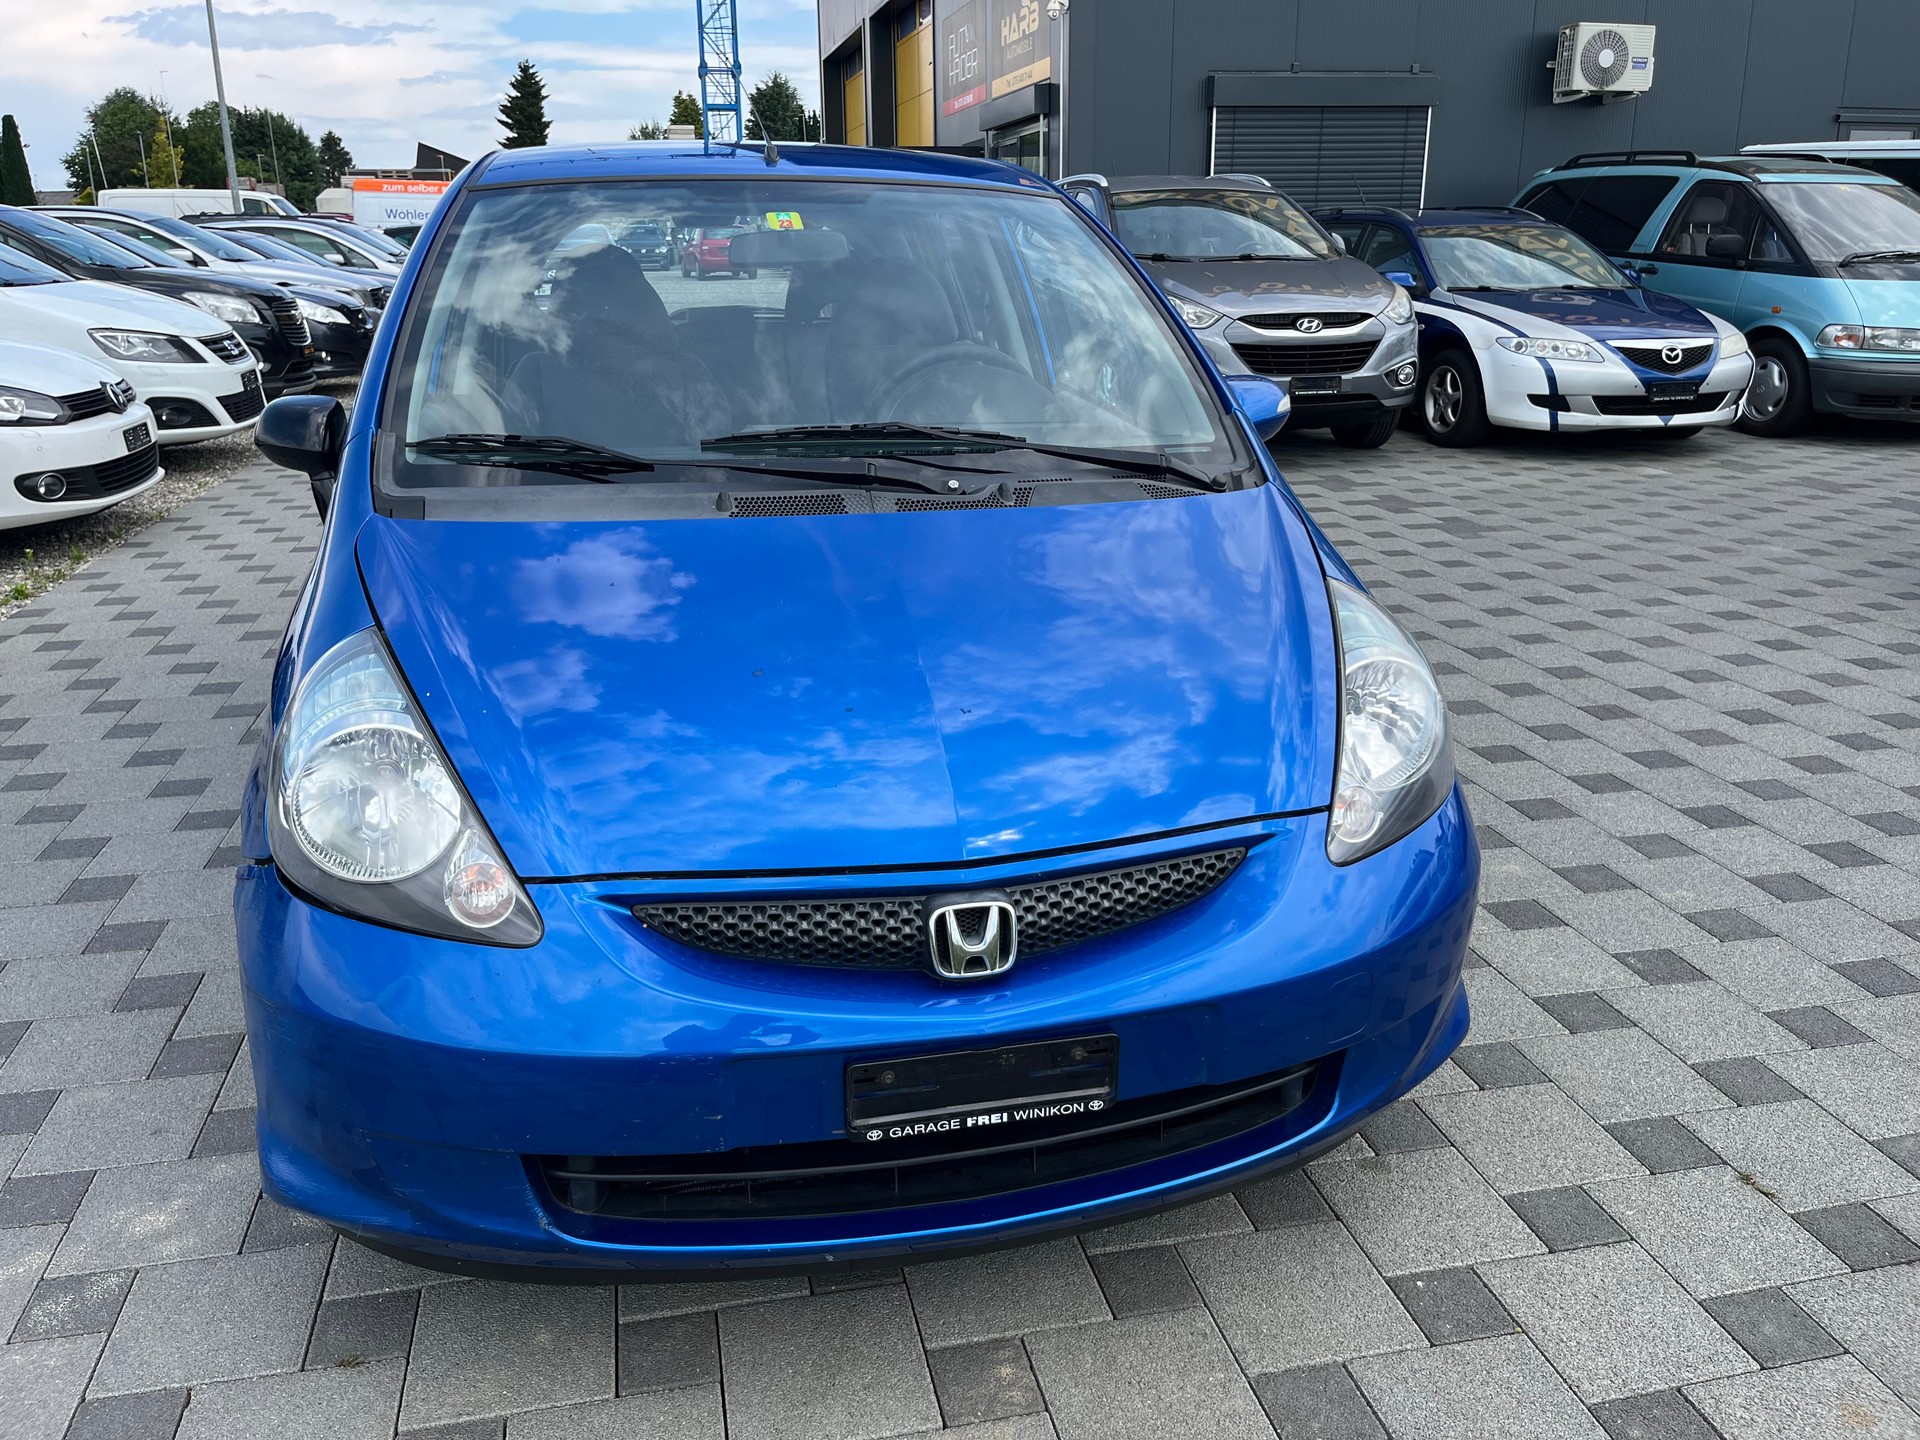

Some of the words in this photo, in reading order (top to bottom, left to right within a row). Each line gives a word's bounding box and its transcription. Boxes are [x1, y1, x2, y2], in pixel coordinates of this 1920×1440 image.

[1001, 0, 1040, 47] HARB
[382, 183, 405, 192] zum
[407, 183, 439, 193] selber
[889, 1118, 961, 1139] GARAGE
[966, 1112, 1008, 1127] FREI
[1013, 1102, 1085, 1121] WINIKON
